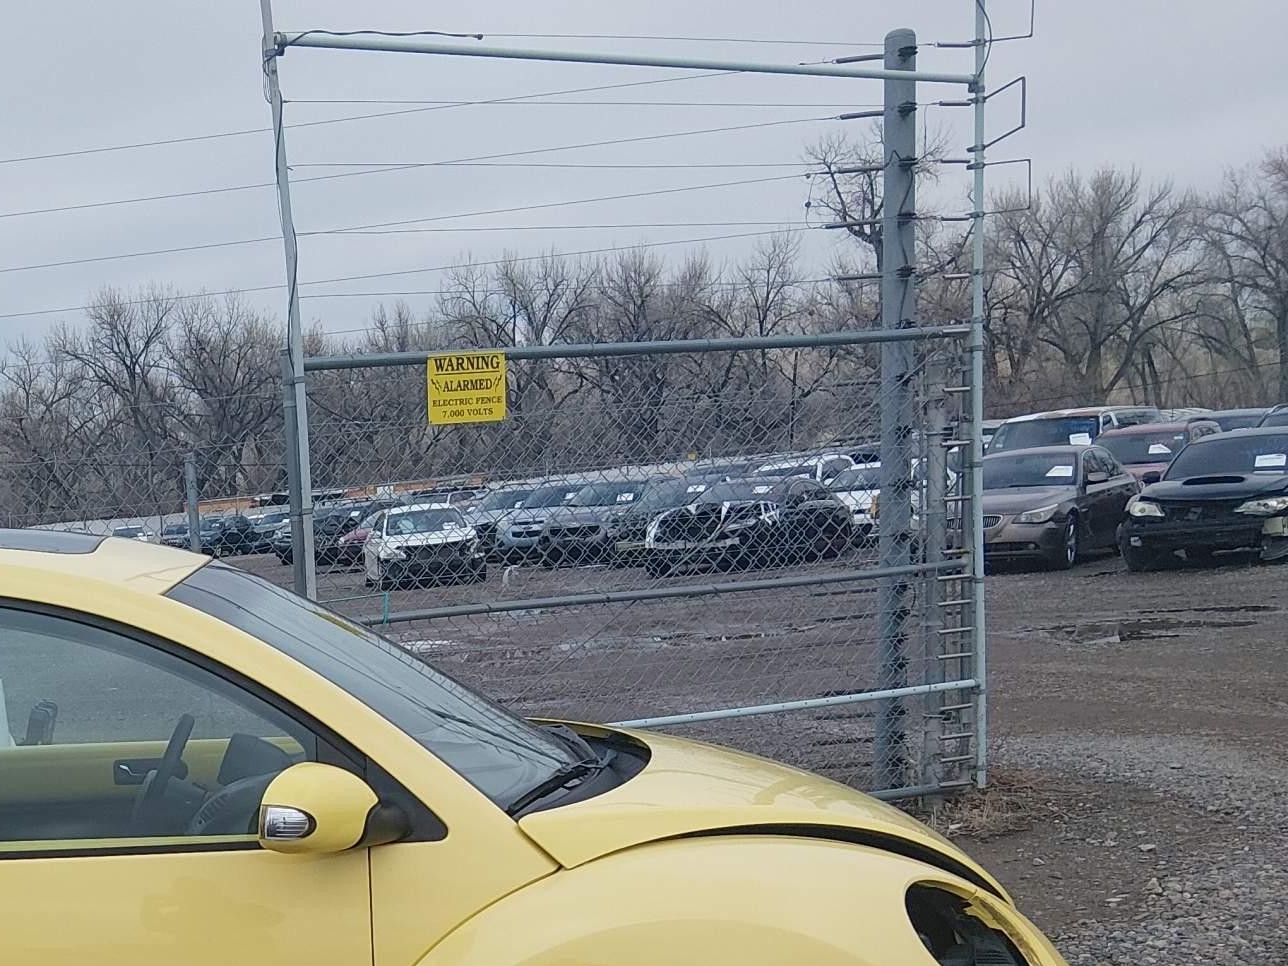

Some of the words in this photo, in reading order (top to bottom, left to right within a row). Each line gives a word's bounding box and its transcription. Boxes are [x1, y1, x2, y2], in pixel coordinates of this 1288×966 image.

[433, 355, 500, 372] WARNING
[443, 378, 492, 392] ALARMED
[432, 398, 473, 407] ELECTRIC
[476, 396, 503, 404] FENCE
[442, 410, 464, 418] 7,000
[467, 408, 493, 416] VOLTS
